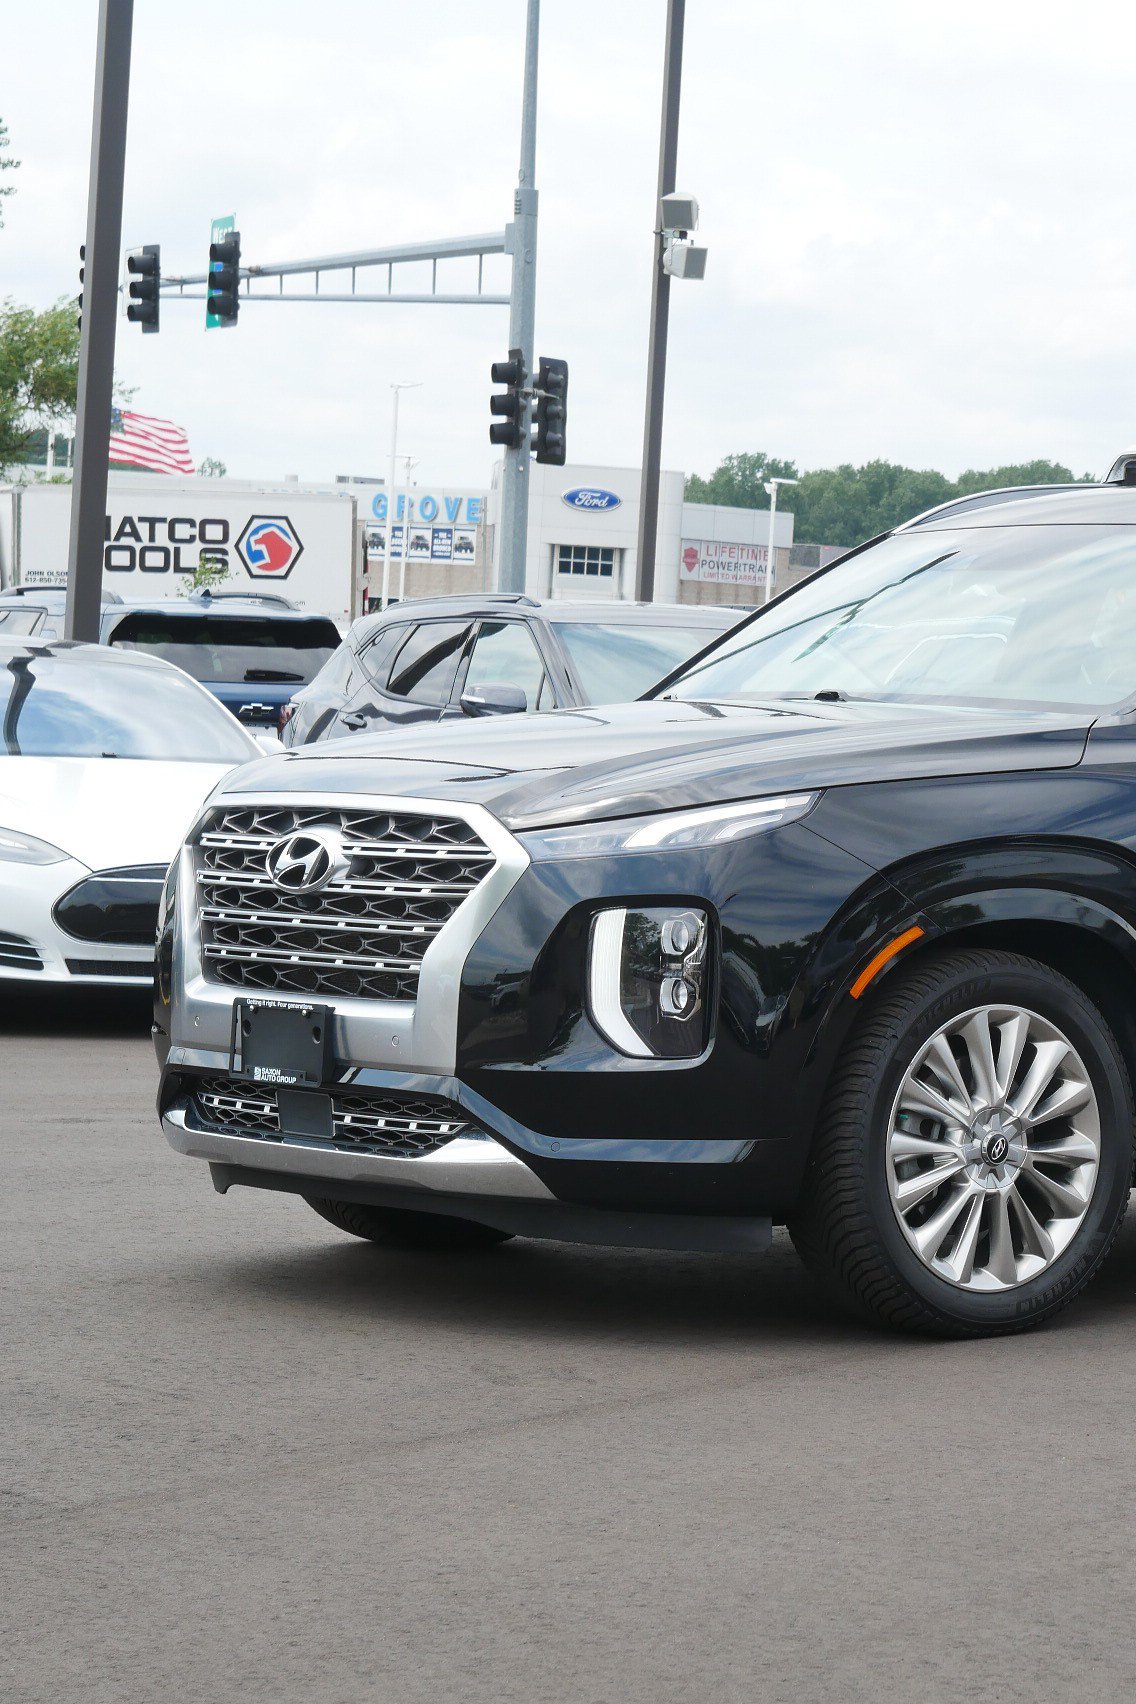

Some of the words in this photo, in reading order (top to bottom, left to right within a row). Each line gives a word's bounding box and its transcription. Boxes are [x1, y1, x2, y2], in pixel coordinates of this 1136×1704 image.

[575, 491, 609, 507] Ford
[372, 493, 482, 522] GROVE
[104, 516, 230, 544] ATCO
[104, 545, 229, 574] OOLS
[706, 545, 769, 562] LIFETIME
[731, 574, 768, 583] WARRANT
[261, 1067, 281, 1076] SAXON
[261, 1074, 276, 1082] AUTO
[276, 1075, 297, 1084] GROUP
